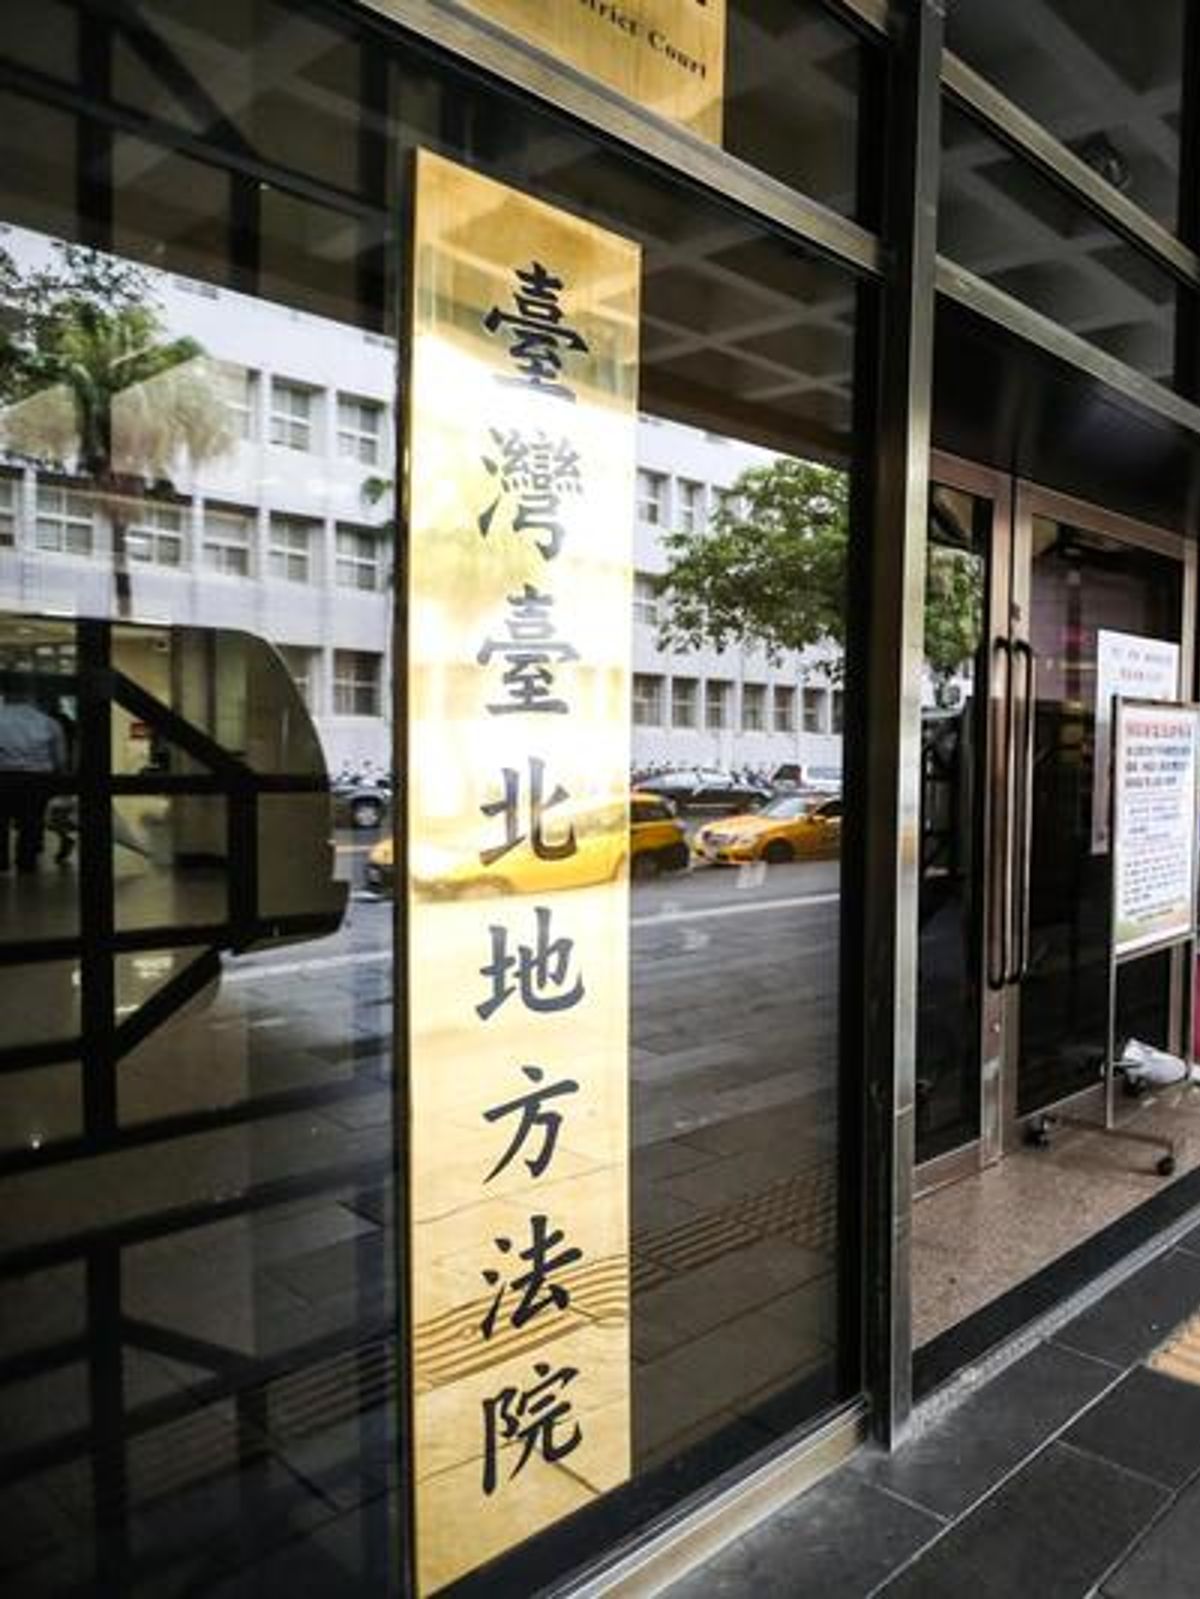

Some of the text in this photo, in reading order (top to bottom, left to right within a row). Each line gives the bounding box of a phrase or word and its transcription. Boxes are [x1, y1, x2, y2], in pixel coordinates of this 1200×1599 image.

[647, 30, 706, 79] Court
[475, 261, 590, 1496] 臺灣臺北地方法院
